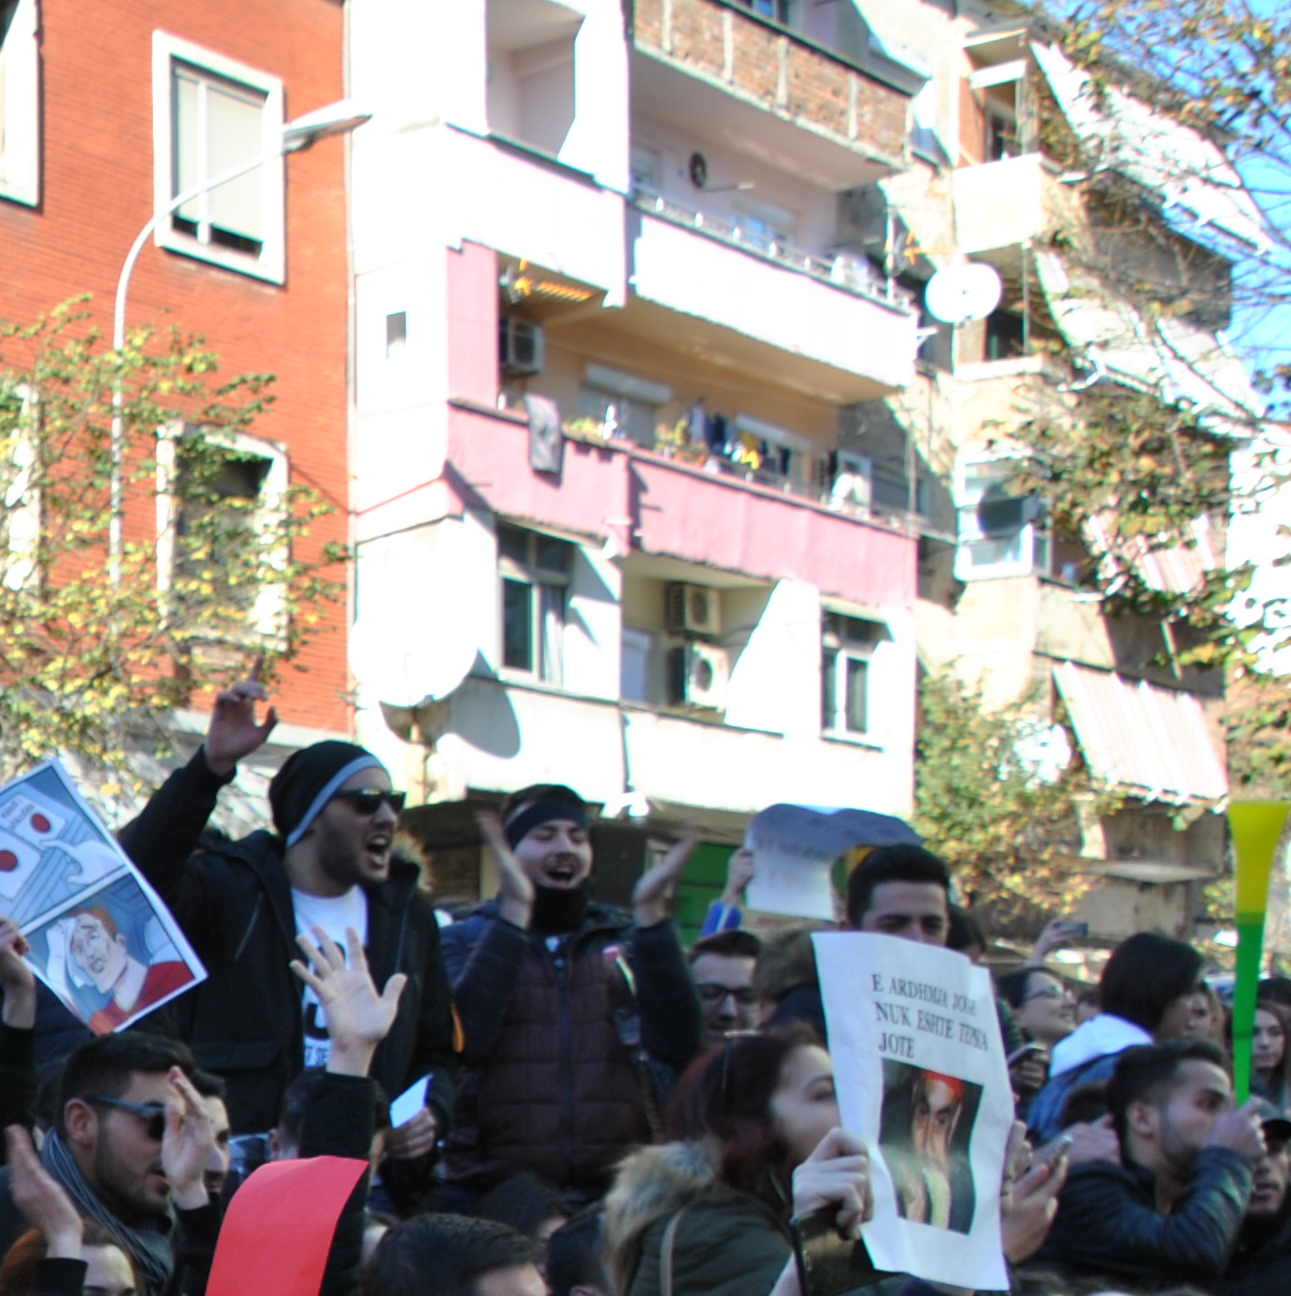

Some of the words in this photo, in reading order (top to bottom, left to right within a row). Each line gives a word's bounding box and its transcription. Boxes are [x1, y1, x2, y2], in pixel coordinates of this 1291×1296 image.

[871, 974, 883, 992] E
[874, 1002, 911, 1027] NUK
[917, 1010, 954, 1039] ESHTE
[878, 1032, 915, 1058] JOTE
